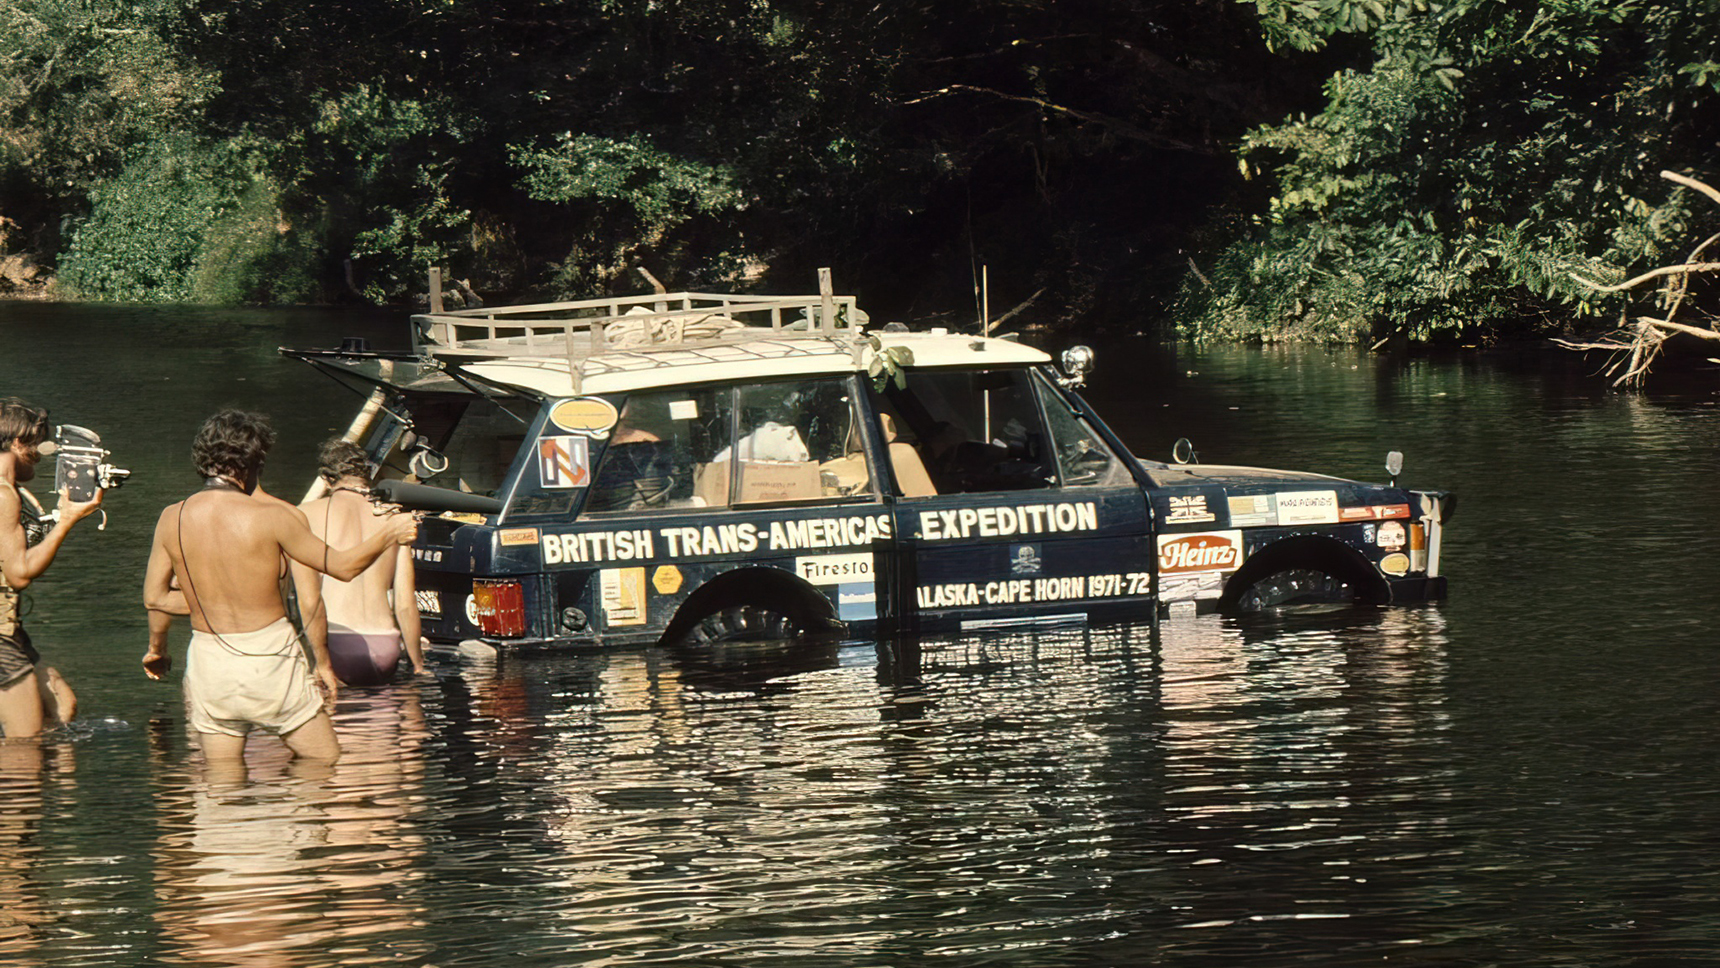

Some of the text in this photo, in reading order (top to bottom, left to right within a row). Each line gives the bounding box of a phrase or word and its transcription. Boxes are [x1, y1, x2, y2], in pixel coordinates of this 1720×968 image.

[542, 502, 1098, 564] BRITISH TRANS-AMERICAS EXPEDITION
[1160, 541, 1235, 569] Heinz
[1034, 576, 1085, 601] HORN
[1088, 572, 1150, 597] 1971-72
